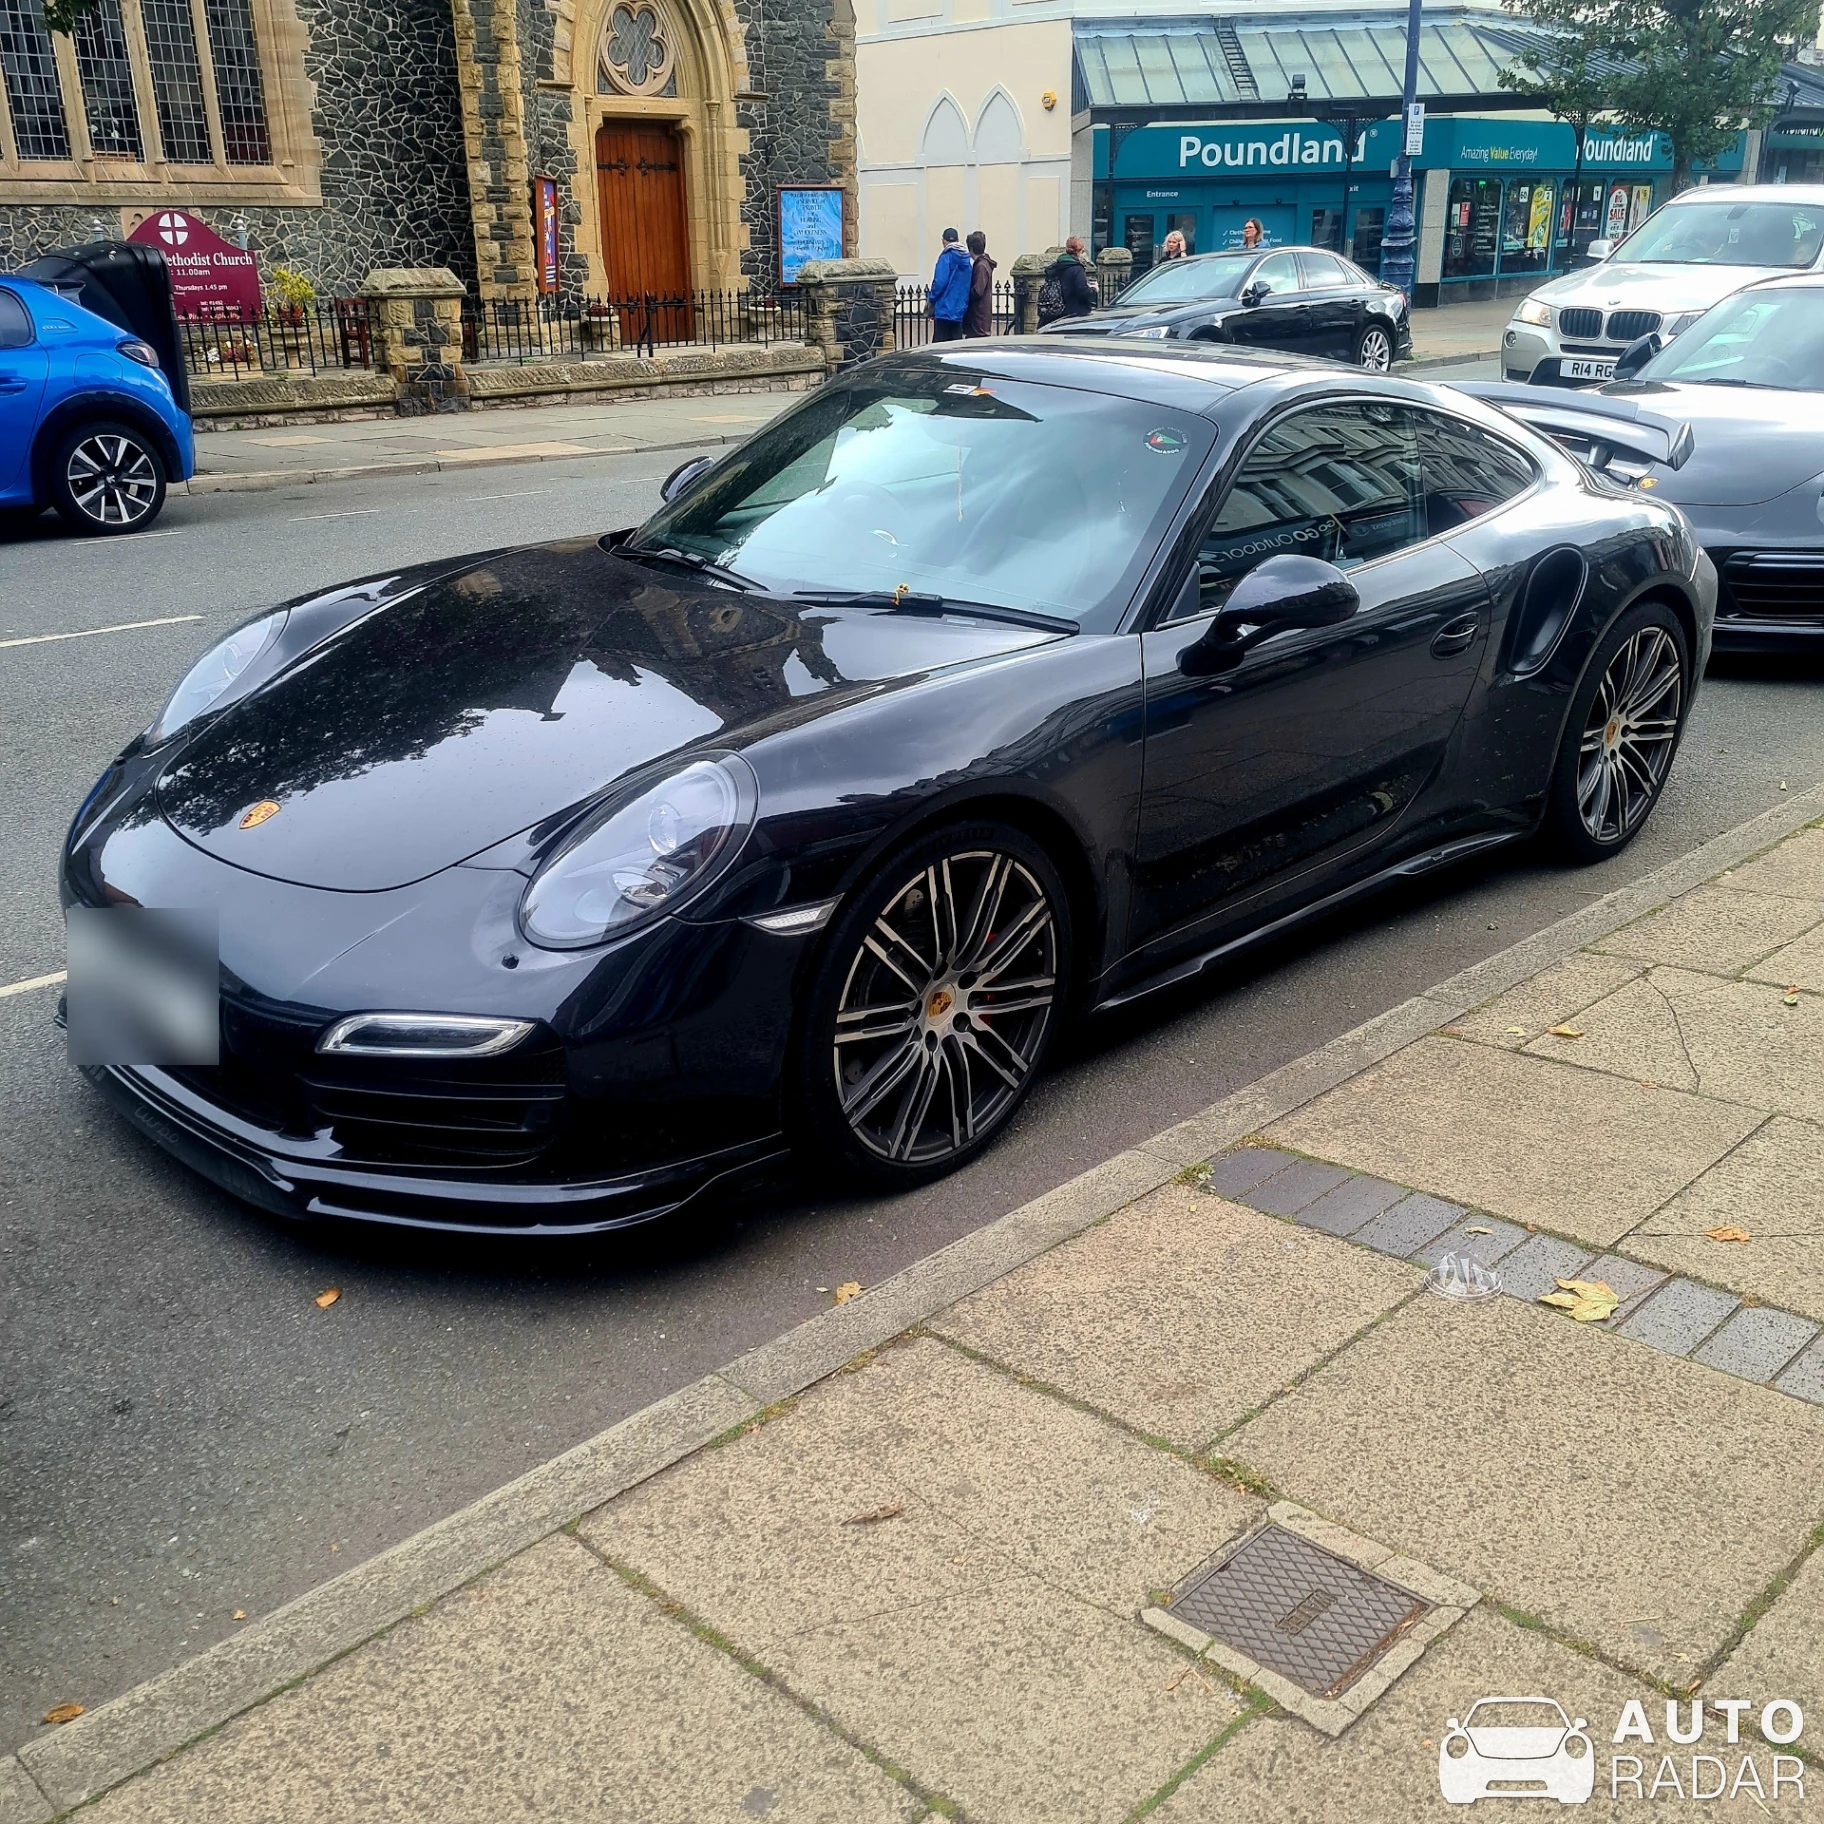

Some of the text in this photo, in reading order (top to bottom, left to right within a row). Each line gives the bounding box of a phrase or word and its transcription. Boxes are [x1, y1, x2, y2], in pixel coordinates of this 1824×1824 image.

[1179, 133, 1366, 168] Poundland
[1460, 145, 1538, 163] Amazing Value Everyday!
[1146, 190, 1179, 198] Entrance
[1349, 184, 1359, 193] xit
[1609, 208, 1625, 220] SALE
[167, 251, 253, 266] ethodist Church
[176, 268, 211, 276] 11.00am
[1571, 362, 1617, 378] R14 RG
